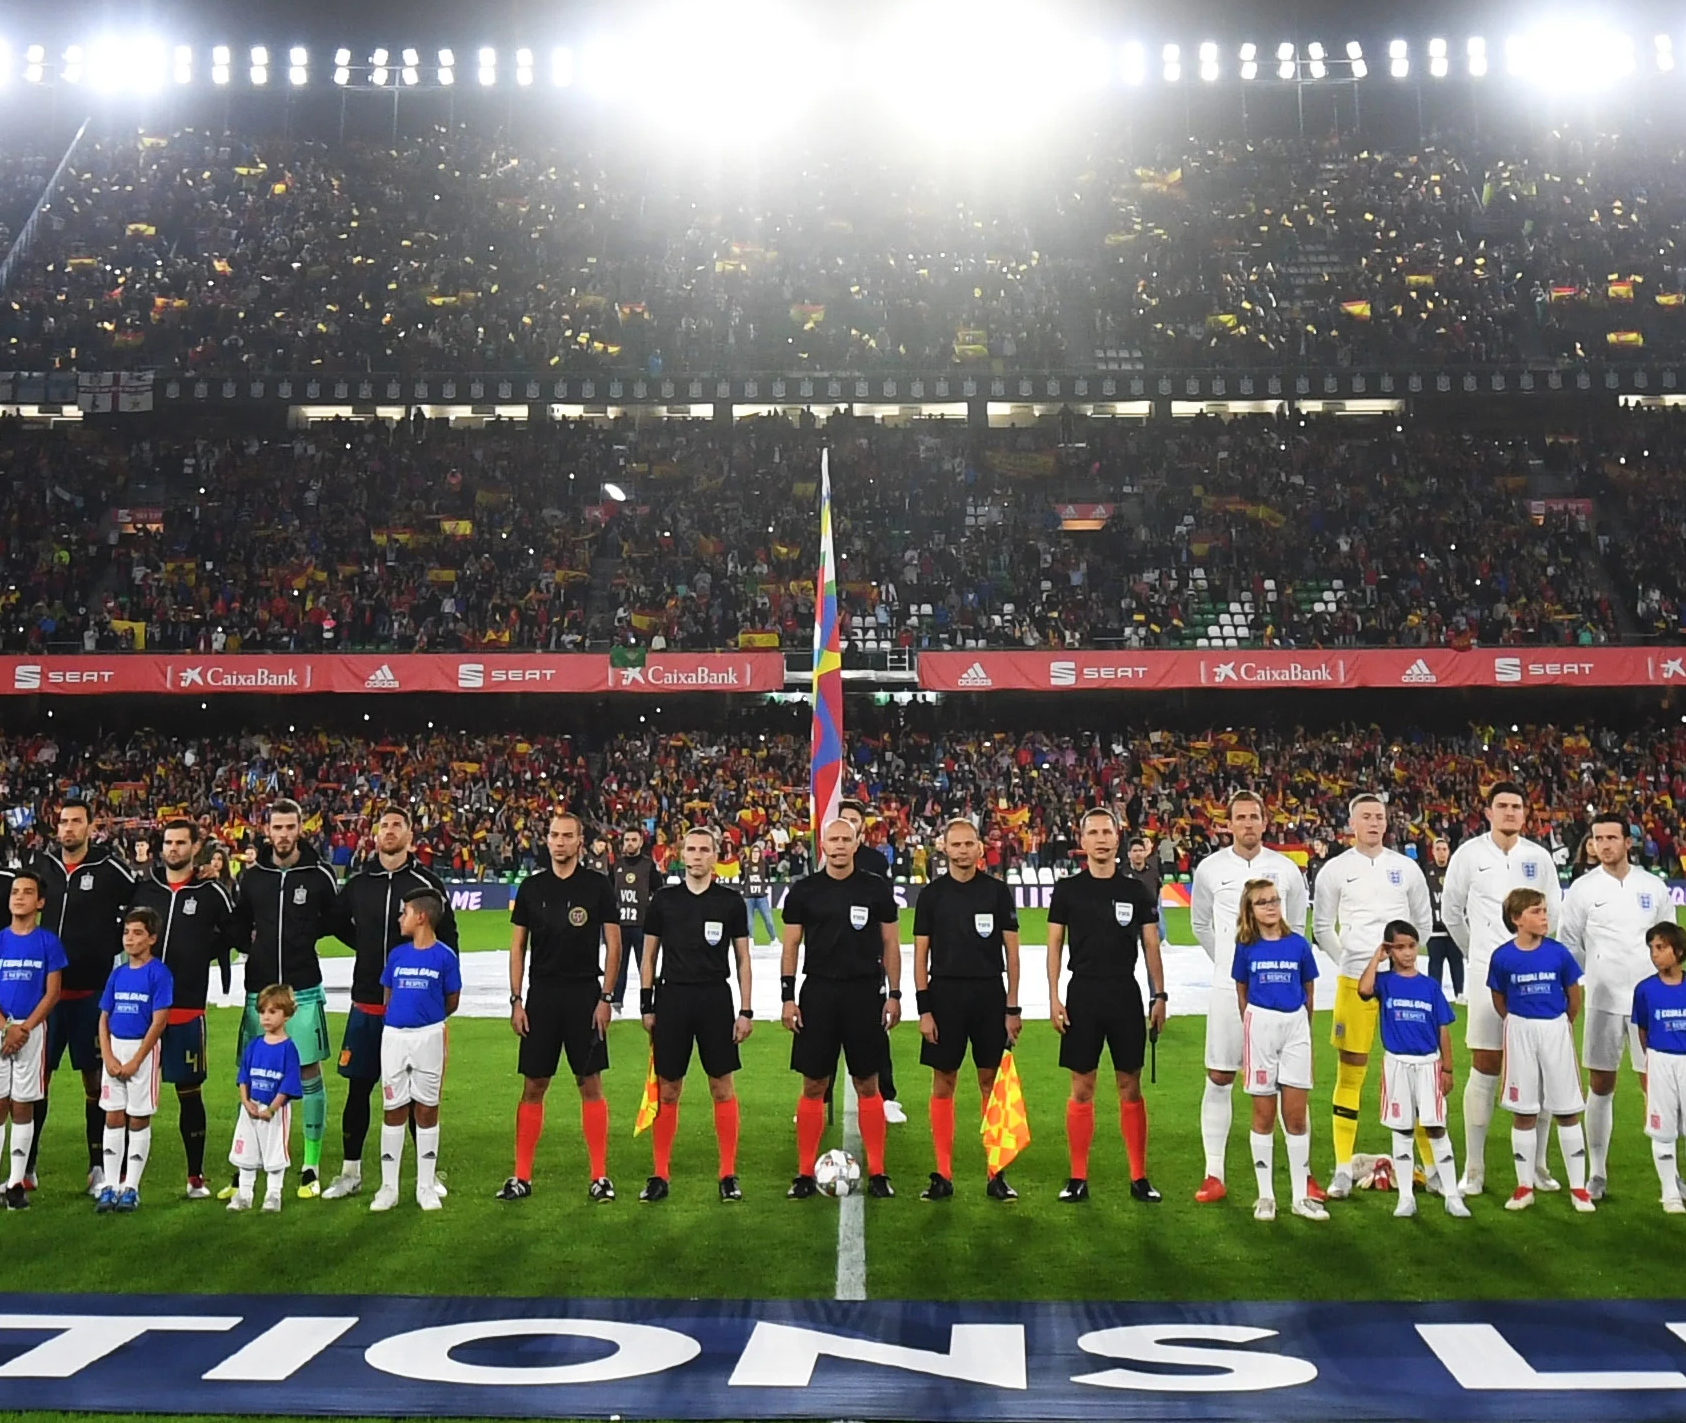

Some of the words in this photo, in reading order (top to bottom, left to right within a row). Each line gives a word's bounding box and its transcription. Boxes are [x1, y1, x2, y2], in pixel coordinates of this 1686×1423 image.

[48, 670, 114, 683] SEAT
[491, 669, 556, 682] SEAT
[648, 666, 738, 687] CaixaBank
[1083, 666, 1148, 680] SEAT
[1239, 663, 1332, 683] CaixaBank
[1528, 663, 1594, 676] SEAT
[206, 668, 298, 688] CaixaBank
[364, 675, 399, 688] adidas
[958, 674, 992, 687] adidas
[1401, 671, 1436, 684] adidas
[447, 890, 482, 910] ME
[620, 889, 638, 904] VOL
[620, 907, 638, 922] 212
[185, 1049, 197, 1071] 4
